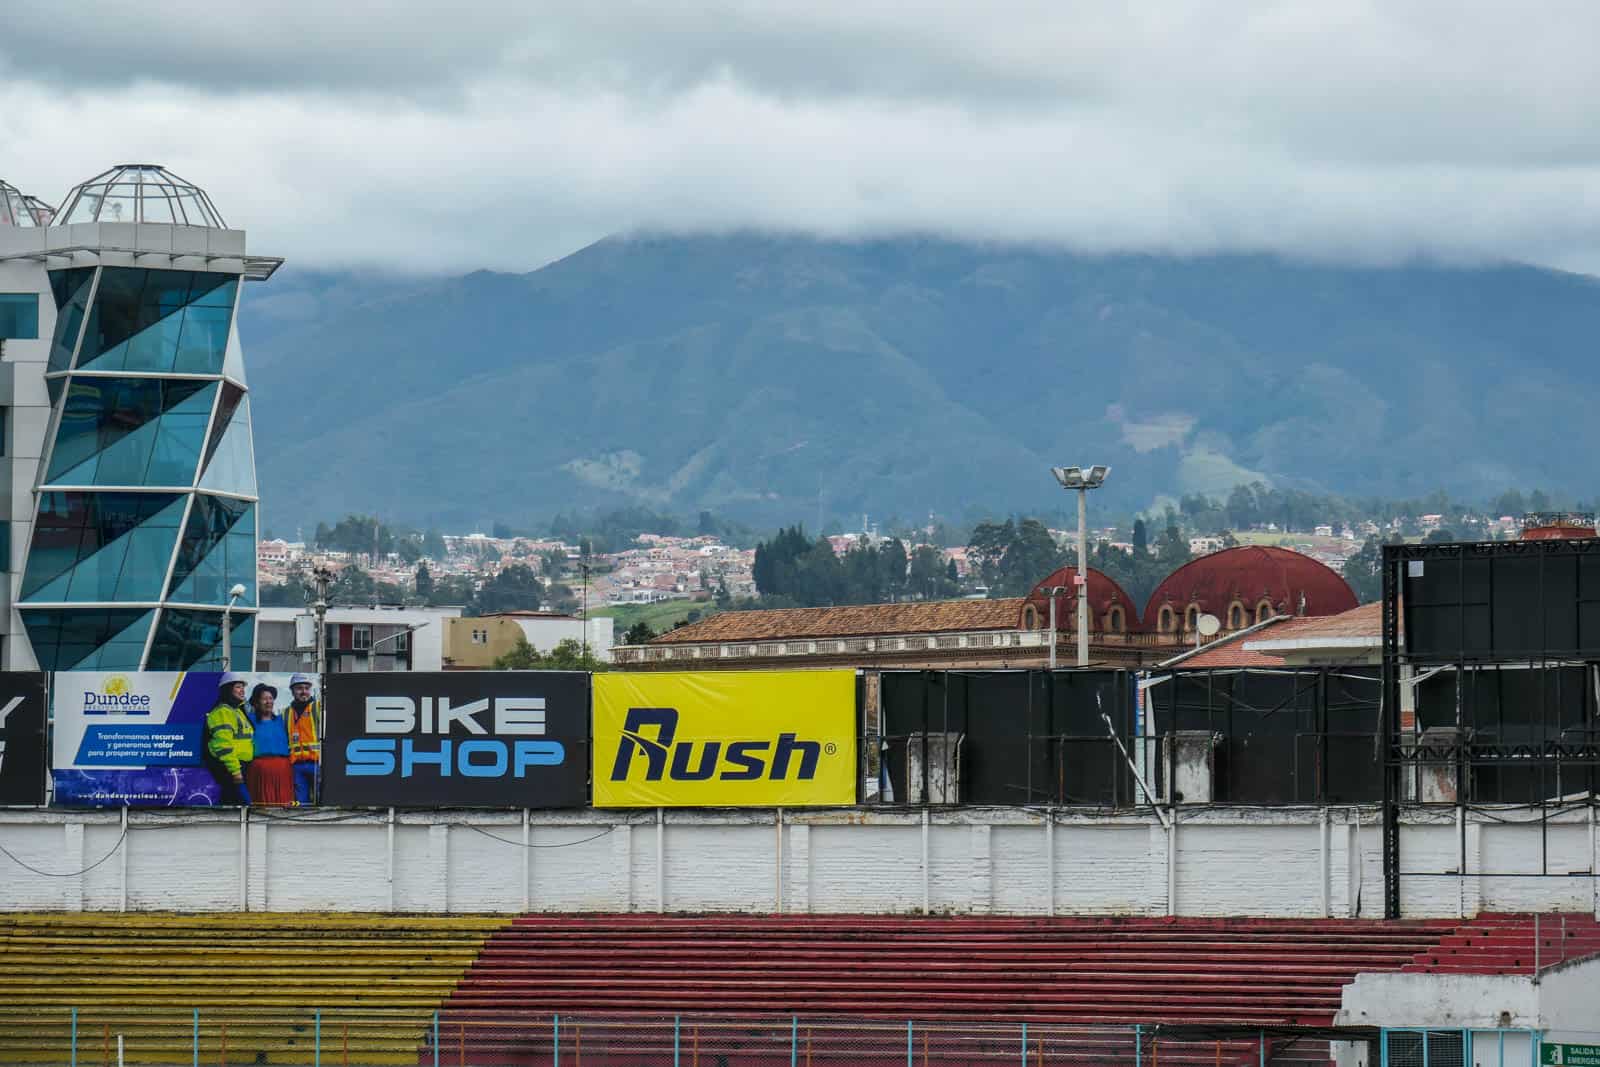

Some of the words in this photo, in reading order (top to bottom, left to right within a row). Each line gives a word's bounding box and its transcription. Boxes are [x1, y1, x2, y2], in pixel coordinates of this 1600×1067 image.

[84, 692, 150, 705] Dundee
[365, 696, 546, 735] BIKE
[97, 732, 150, 741] Transformamos
[153, 741, 175, 749] valor
[168, 749, 193, 759] juntos
[345, 738, 565, 778] SHOP
[1570, 1047, 1594, 1055] SALIDA
